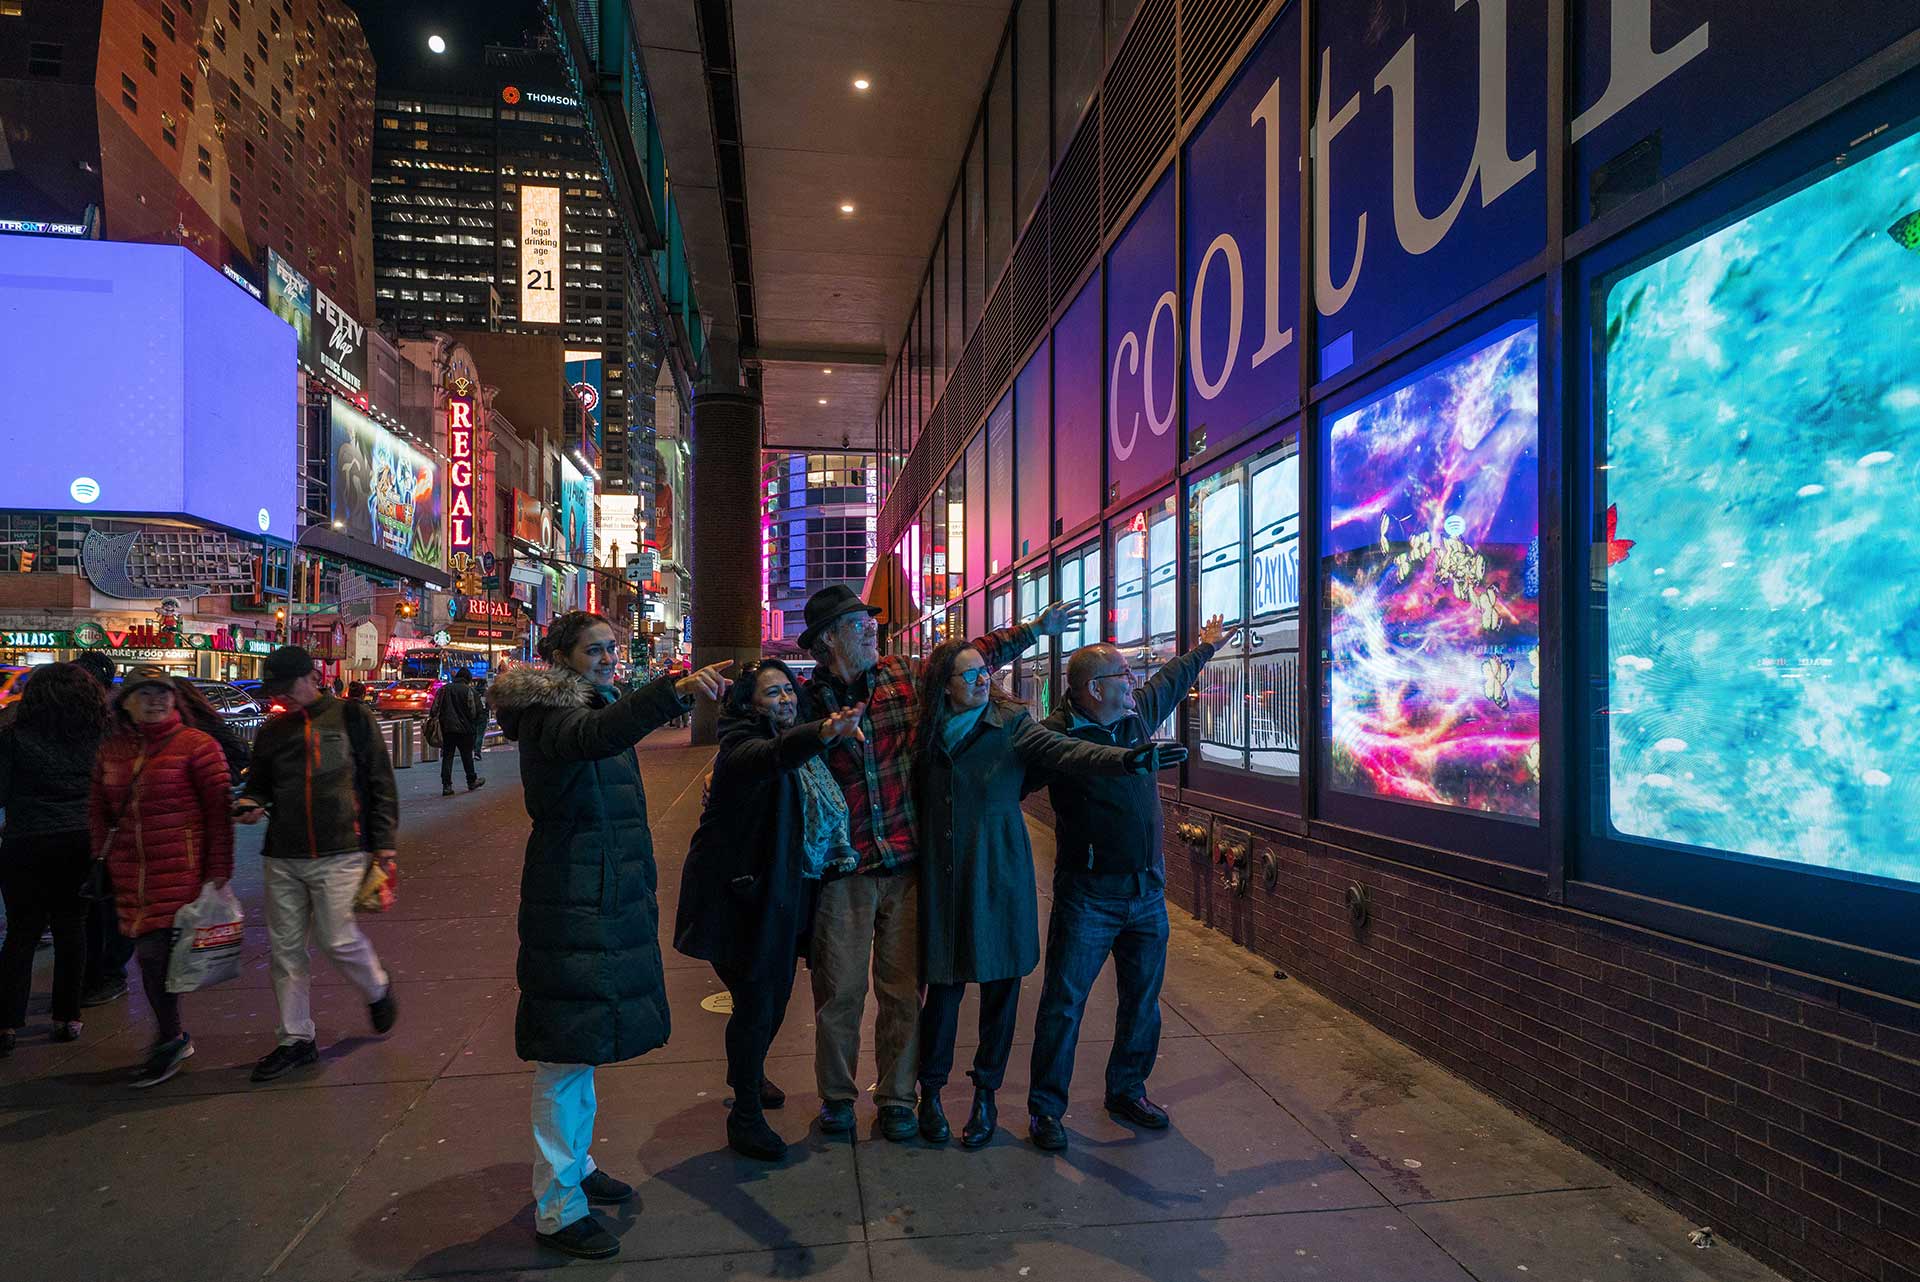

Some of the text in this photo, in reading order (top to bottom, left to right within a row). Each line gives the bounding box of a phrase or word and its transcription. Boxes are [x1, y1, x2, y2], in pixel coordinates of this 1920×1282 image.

[526, 92, 577, 107] THOMSON
[534, 219, 548, 227] The
[531, 227, 551, 236] legal
[524, 238, 558, 249] drinking
[533, 248, 548, 256] age
[527, 269, 555, 291] 21
[316, 288, 364, 348] FETTY
[328, 324, 354, 364] Wap
[451, 402, 473, 546] REGAL
[468, 599, 512, 616] REGAL
[9, 632, 55, 646] SALADS
[138, 649, 164, 658] FOOD
[165, 649, 195, 660] COURT
